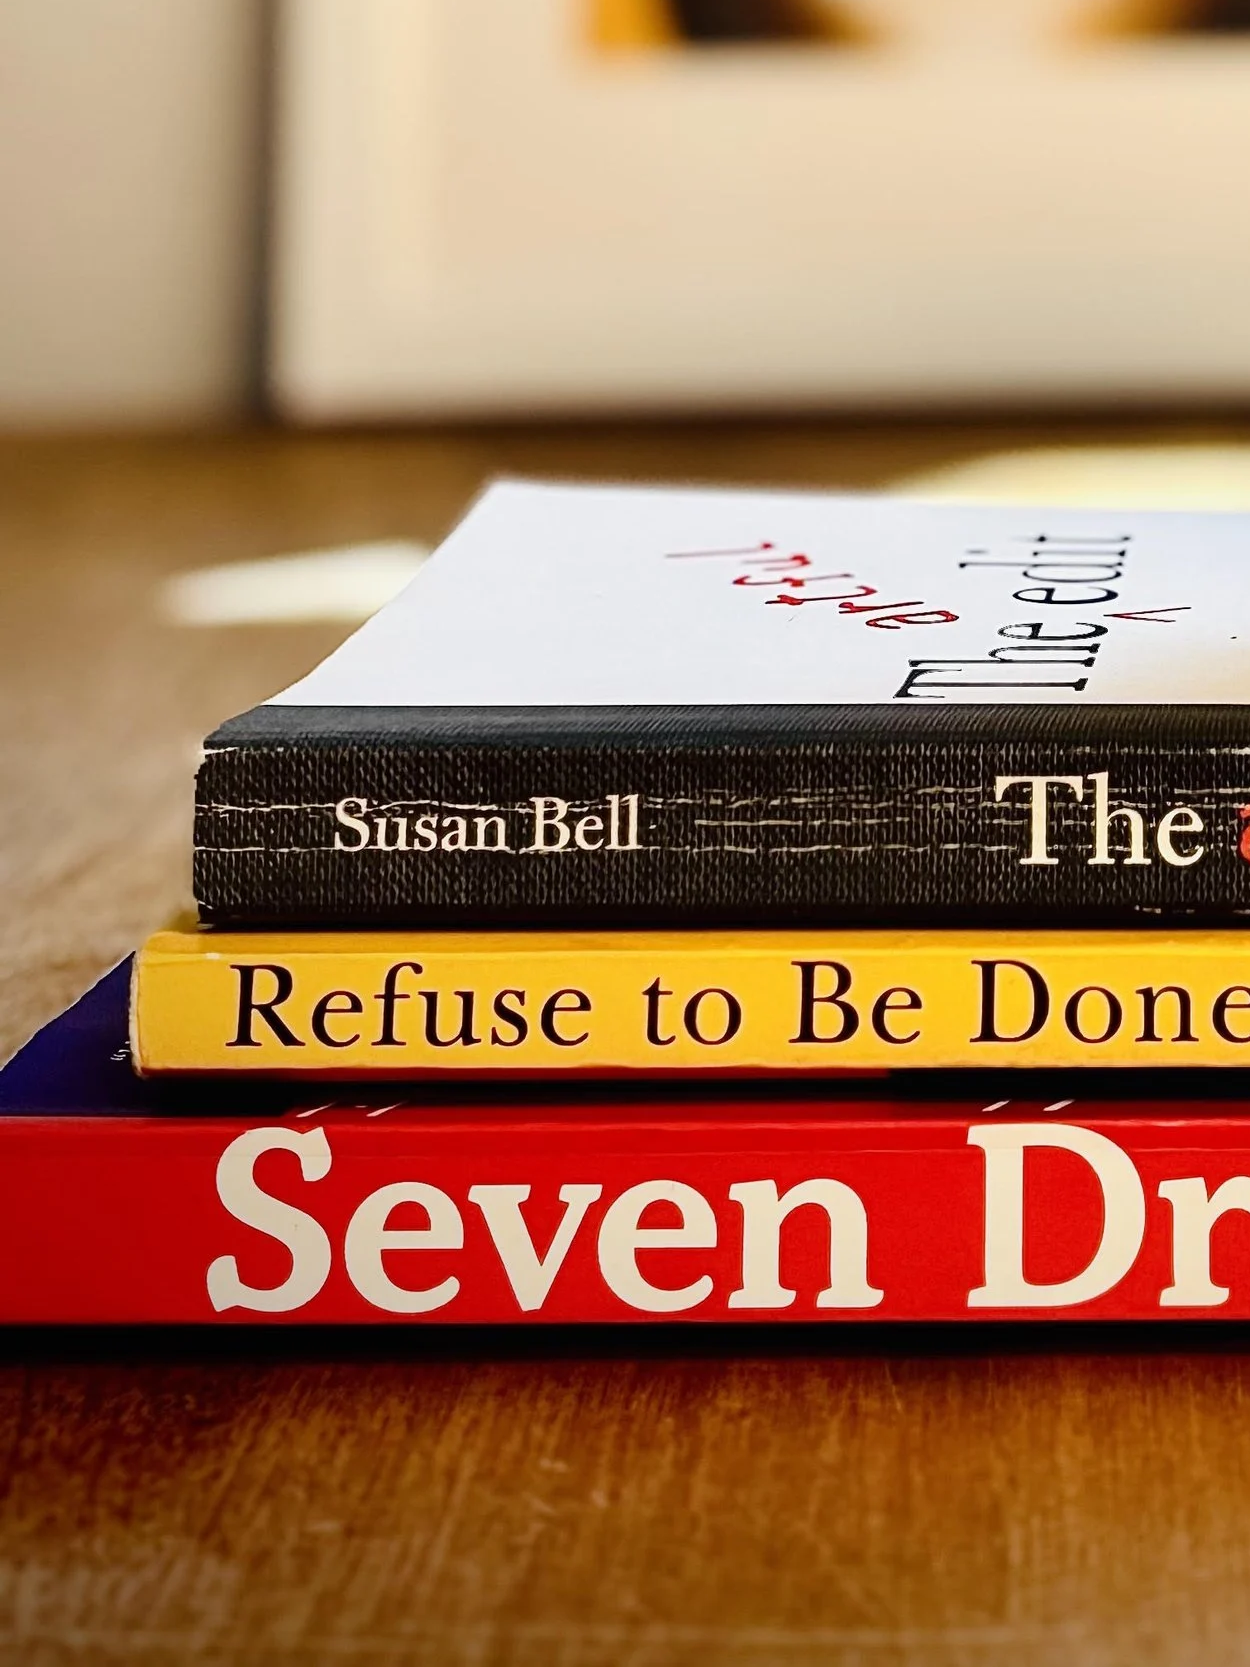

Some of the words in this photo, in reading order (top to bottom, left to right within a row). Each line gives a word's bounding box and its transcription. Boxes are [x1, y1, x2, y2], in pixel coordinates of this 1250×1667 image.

[664, 541, 960, 630] artful
[958, 535, 1133, 606] edit
[893, 622, 1109, 700] The
[334, 796, 509, 852] Susan
[529, 794, 643, 852] Bell
[995, 772, 1205, 867] The
[225, 961, 593, 1048] Refuse
[642, 976, 743, 1046] to
[788, 959, 923, 1045] Be
[205, 1126, 884, 1313] Seven
